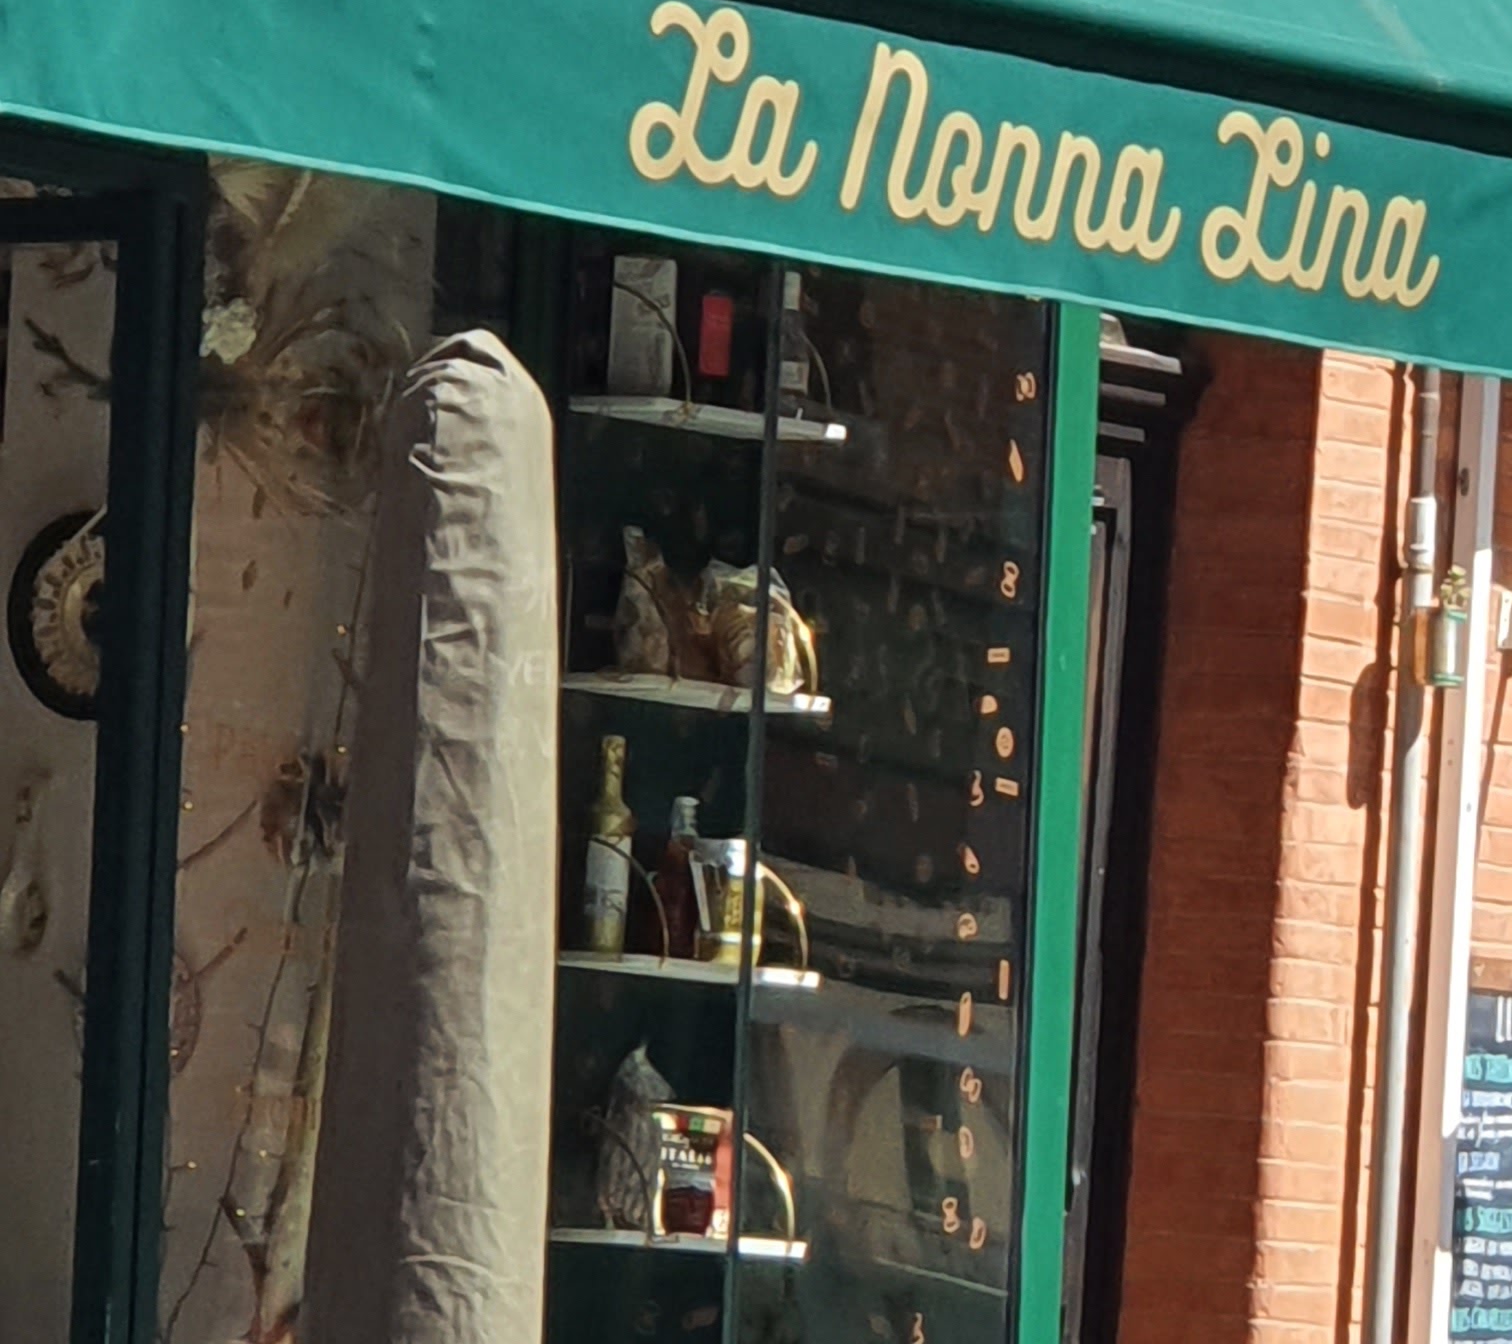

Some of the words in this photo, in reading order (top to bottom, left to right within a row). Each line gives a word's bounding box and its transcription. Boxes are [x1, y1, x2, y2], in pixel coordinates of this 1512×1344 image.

[629, 0, 819, 197] La
[839, 41, 1182, 261] Nonna
[1201, 110, 1441, 308] Lina
